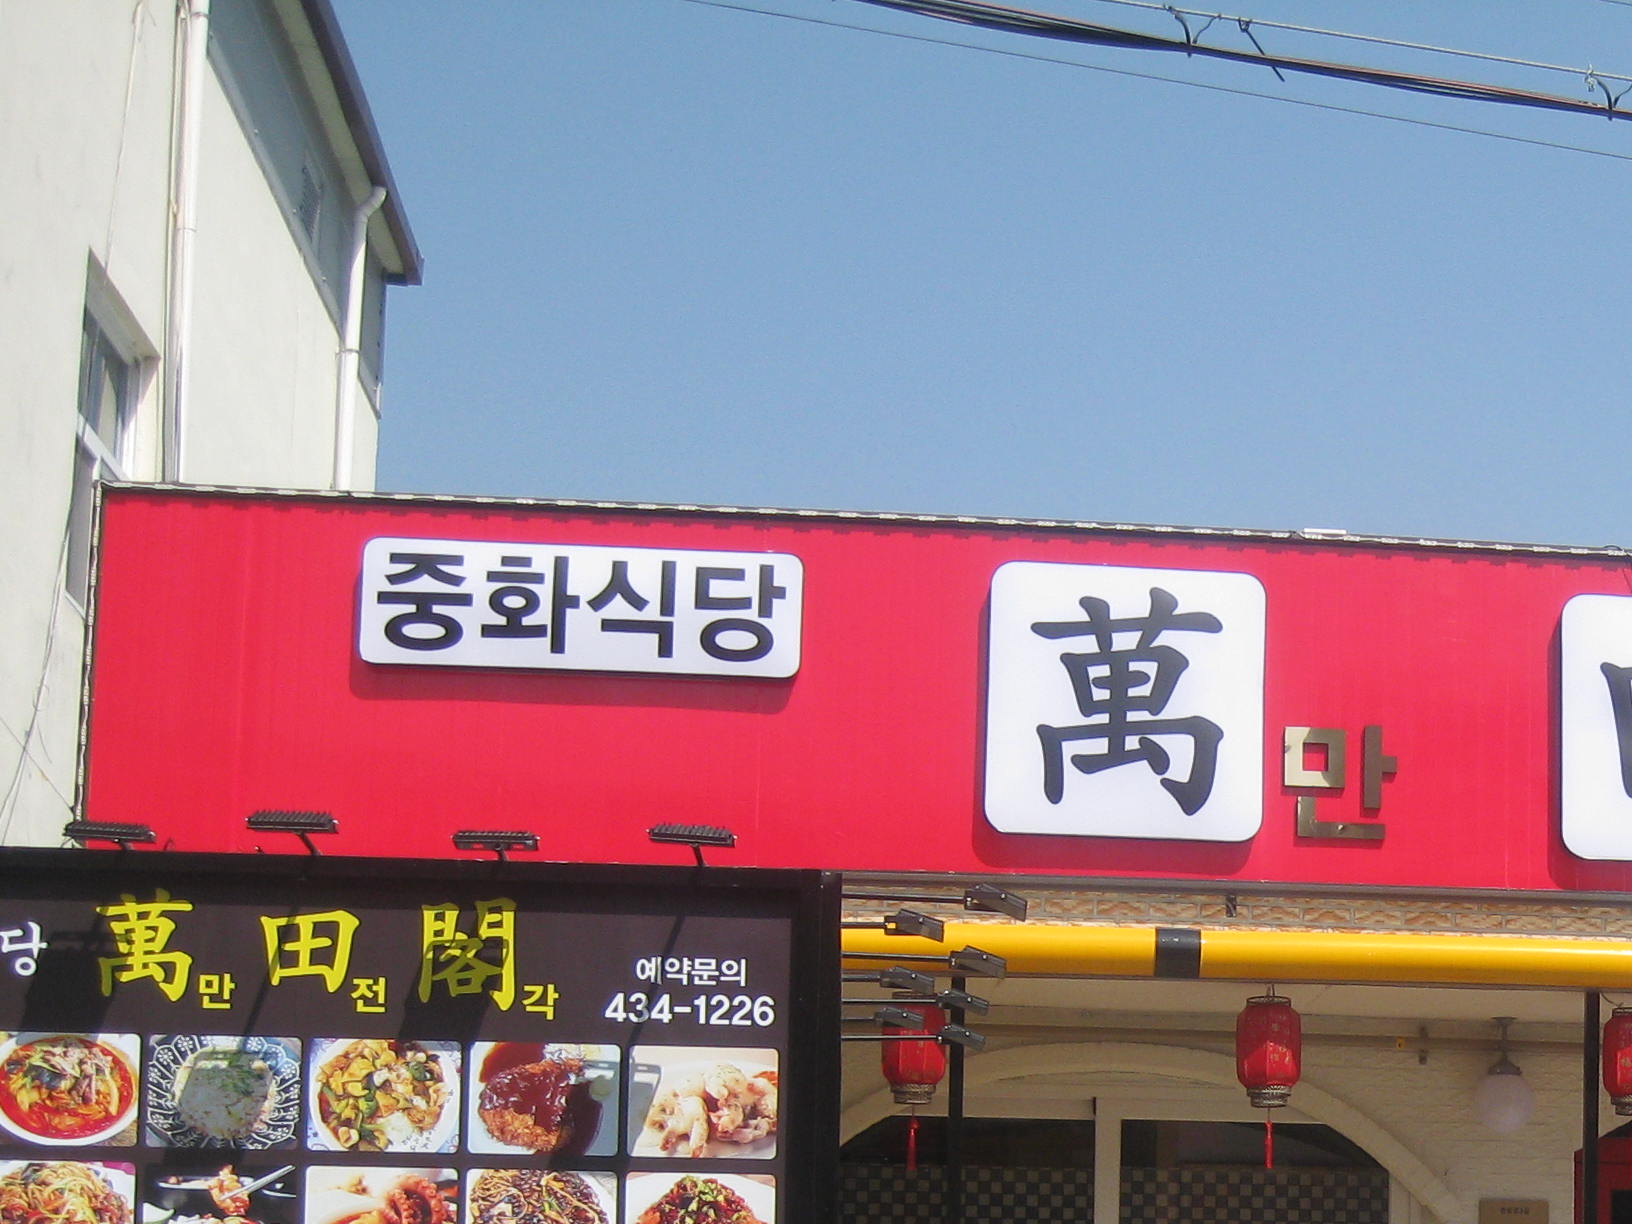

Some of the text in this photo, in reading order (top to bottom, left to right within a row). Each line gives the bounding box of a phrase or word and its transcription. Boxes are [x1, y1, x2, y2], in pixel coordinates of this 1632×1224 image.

[375, 551, 787, 663] 중화식당
[1030, 586, 1224, 816] 萬
[1284, 725, 1397, 840] 만
[0, 921, 48, 976] 당
[96, 887, 193, 1001] 萬
[260, 909, 360, 993] 田
[418, 897, 518, 1011] 閣
[635, 955, 747, 987] 예약문의
[199, 973, 236, 1009] 만
[350, 976, 386, 1013] 전
[521, 983, 560, 1020] 각
[604, 992, 776, 1027] 434-1226
